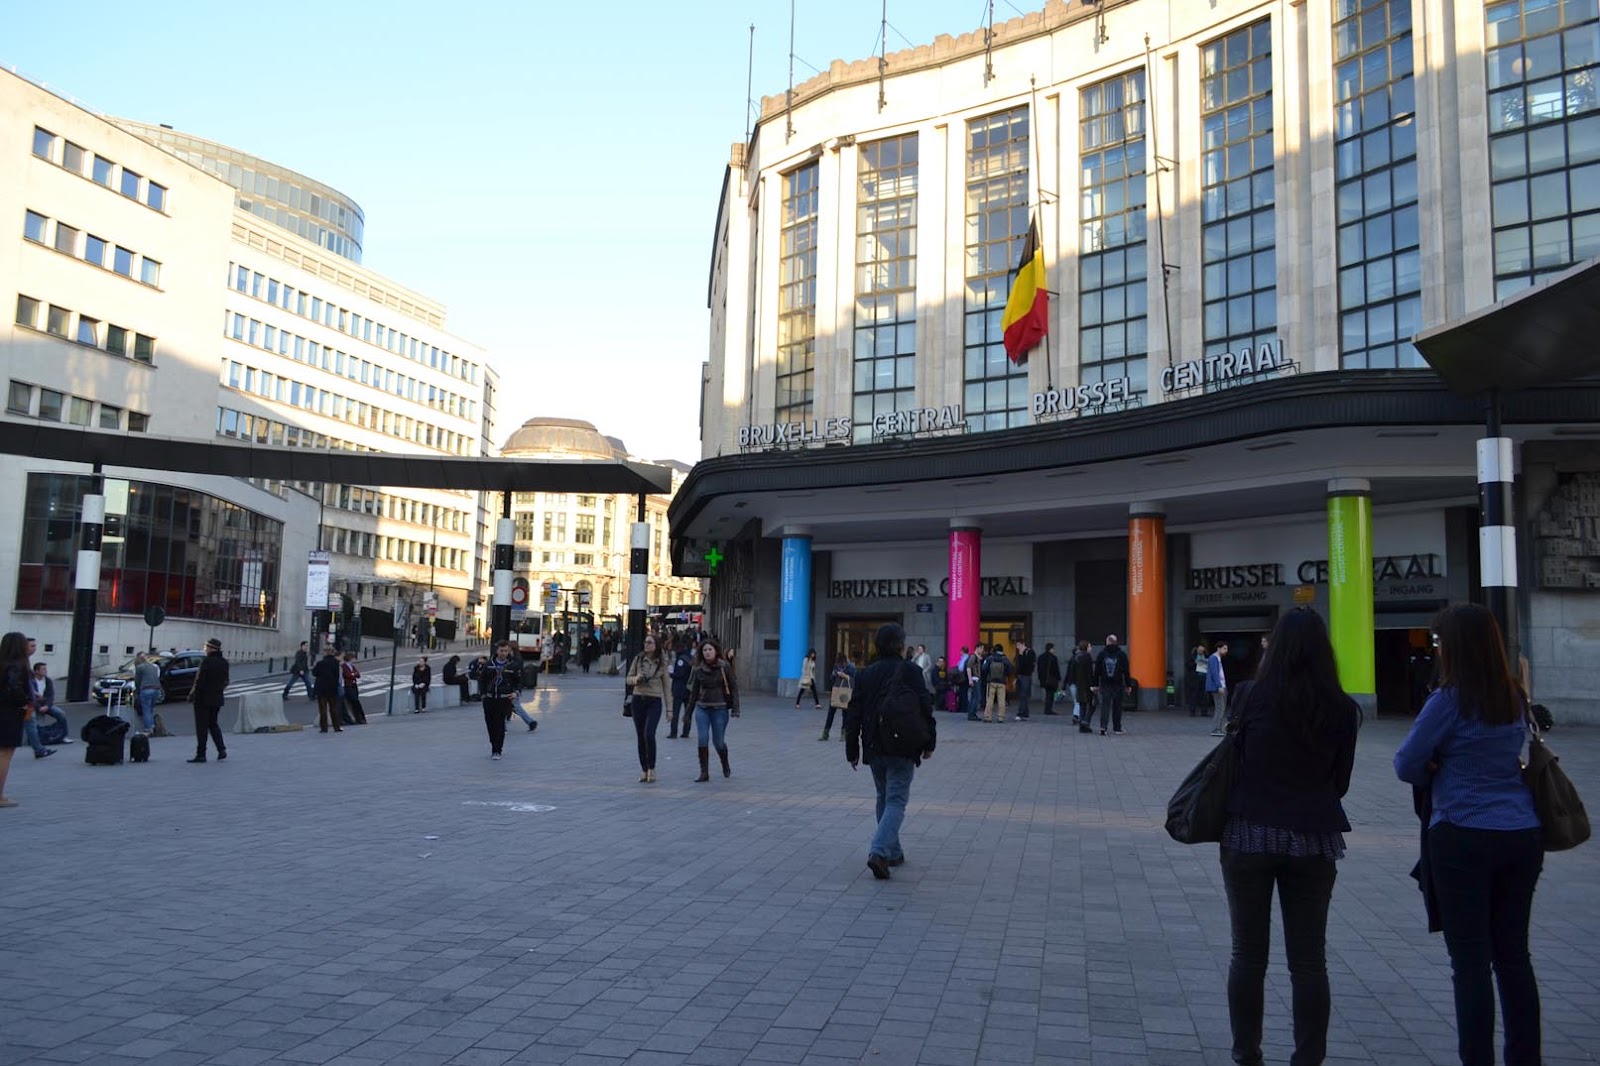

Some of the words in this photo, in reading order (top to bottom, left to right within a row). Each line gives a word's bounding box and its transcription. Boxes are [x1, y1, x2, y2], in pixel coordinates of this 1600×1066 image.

[1033, 376, 1137, 416] BRUSSEL
[1159, 339, 1292, 392] CENTRAAL
[738, 416, 850, 446] BRUXELLES
[872, 404, 966, 435] CENTRAL
[832, 578, 929, 598] BRUXELLES
[940, 576, 1029, 597] CTRAL
[1191, 563, 1286, 589] BRUSSEL
[1297, 553, 1442, 585] CEAAL
[1389, 584, 1434, 597] INGANG
